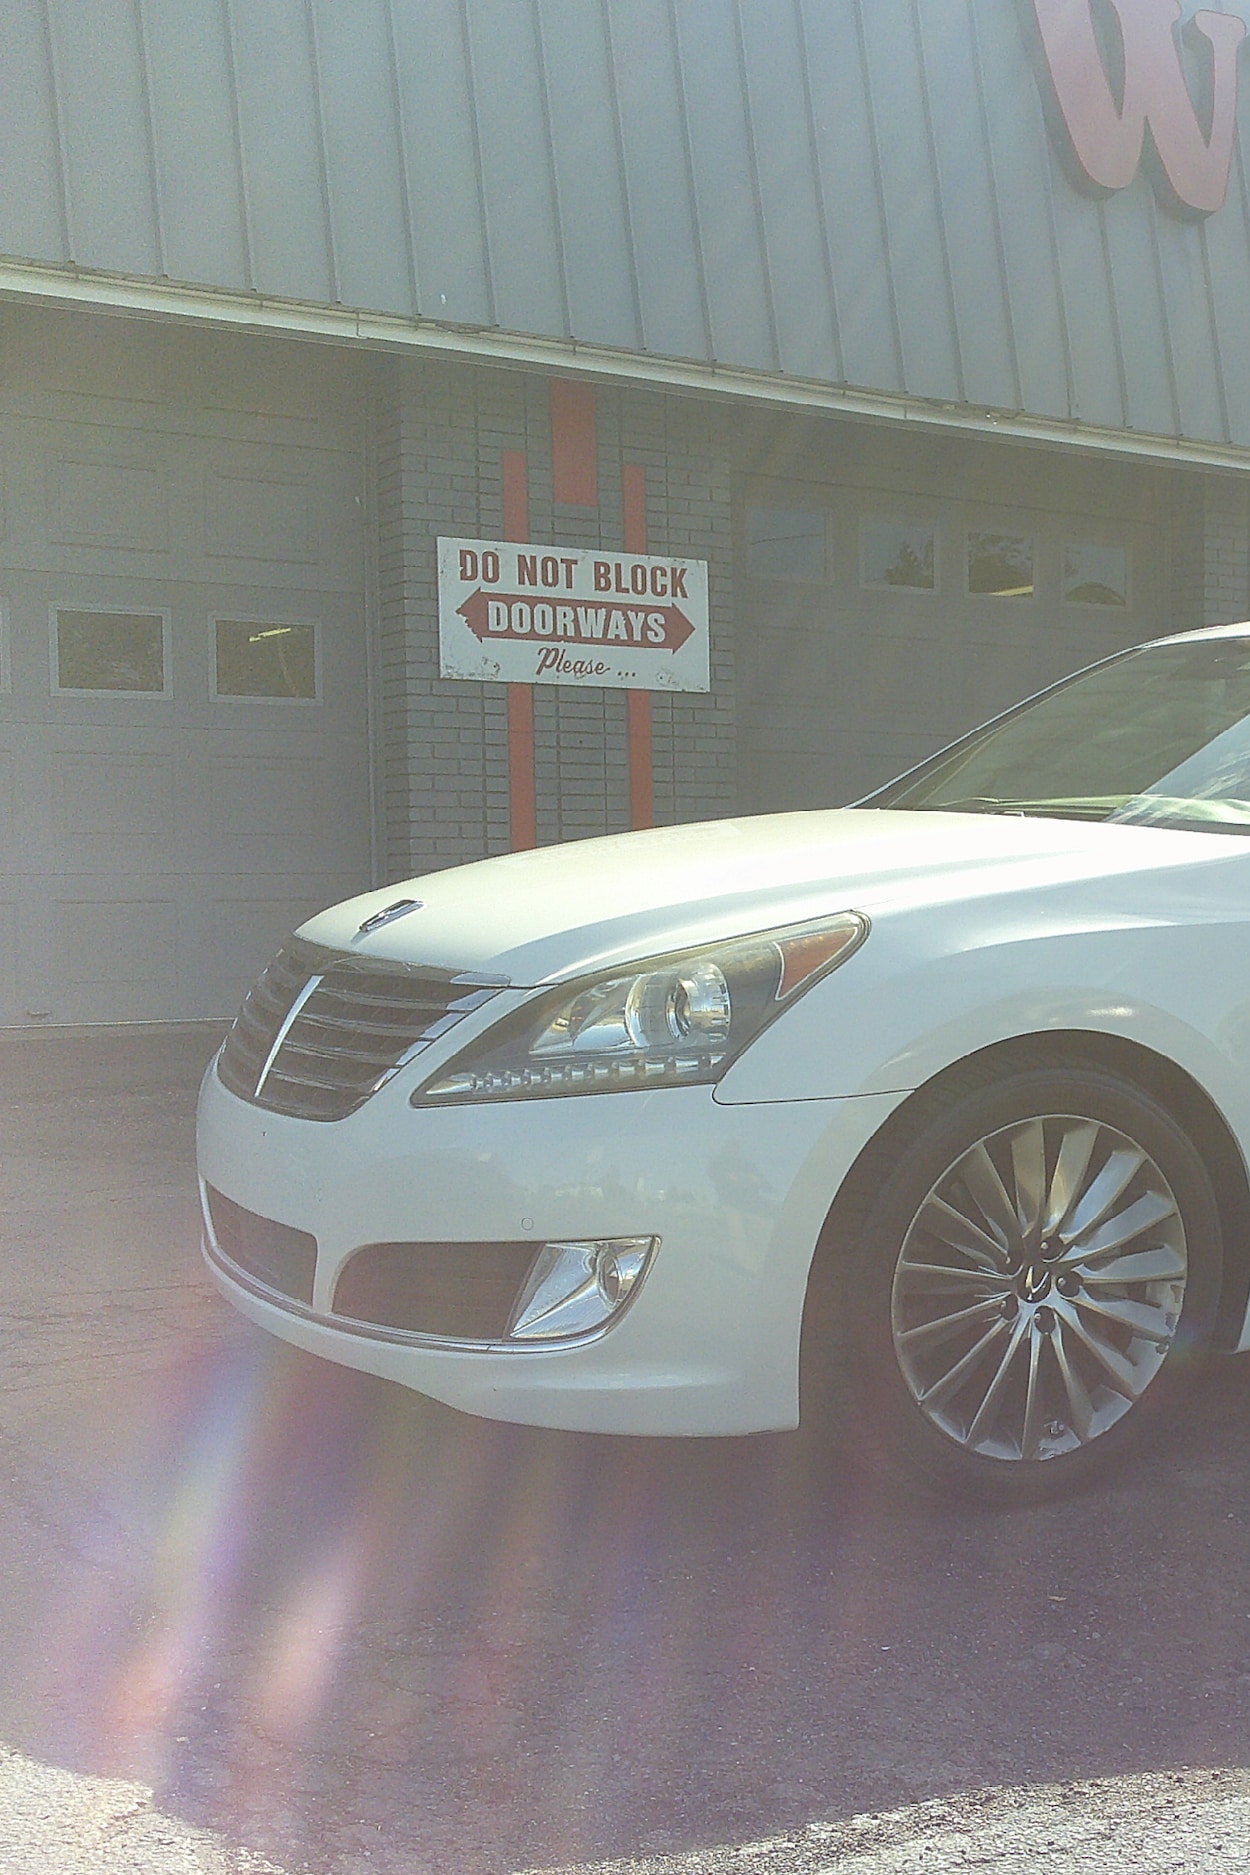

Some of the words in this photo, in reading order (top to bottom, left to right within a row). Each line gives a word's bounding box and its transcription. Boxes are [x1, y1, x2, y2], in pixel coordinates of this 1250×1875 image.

[459, 549, 500, 583] DO
[517, 554, 579, 589] NOT
[594, 561, 689, 599] BLOCK
[487, 600, 667, 644] DOORWAYS
